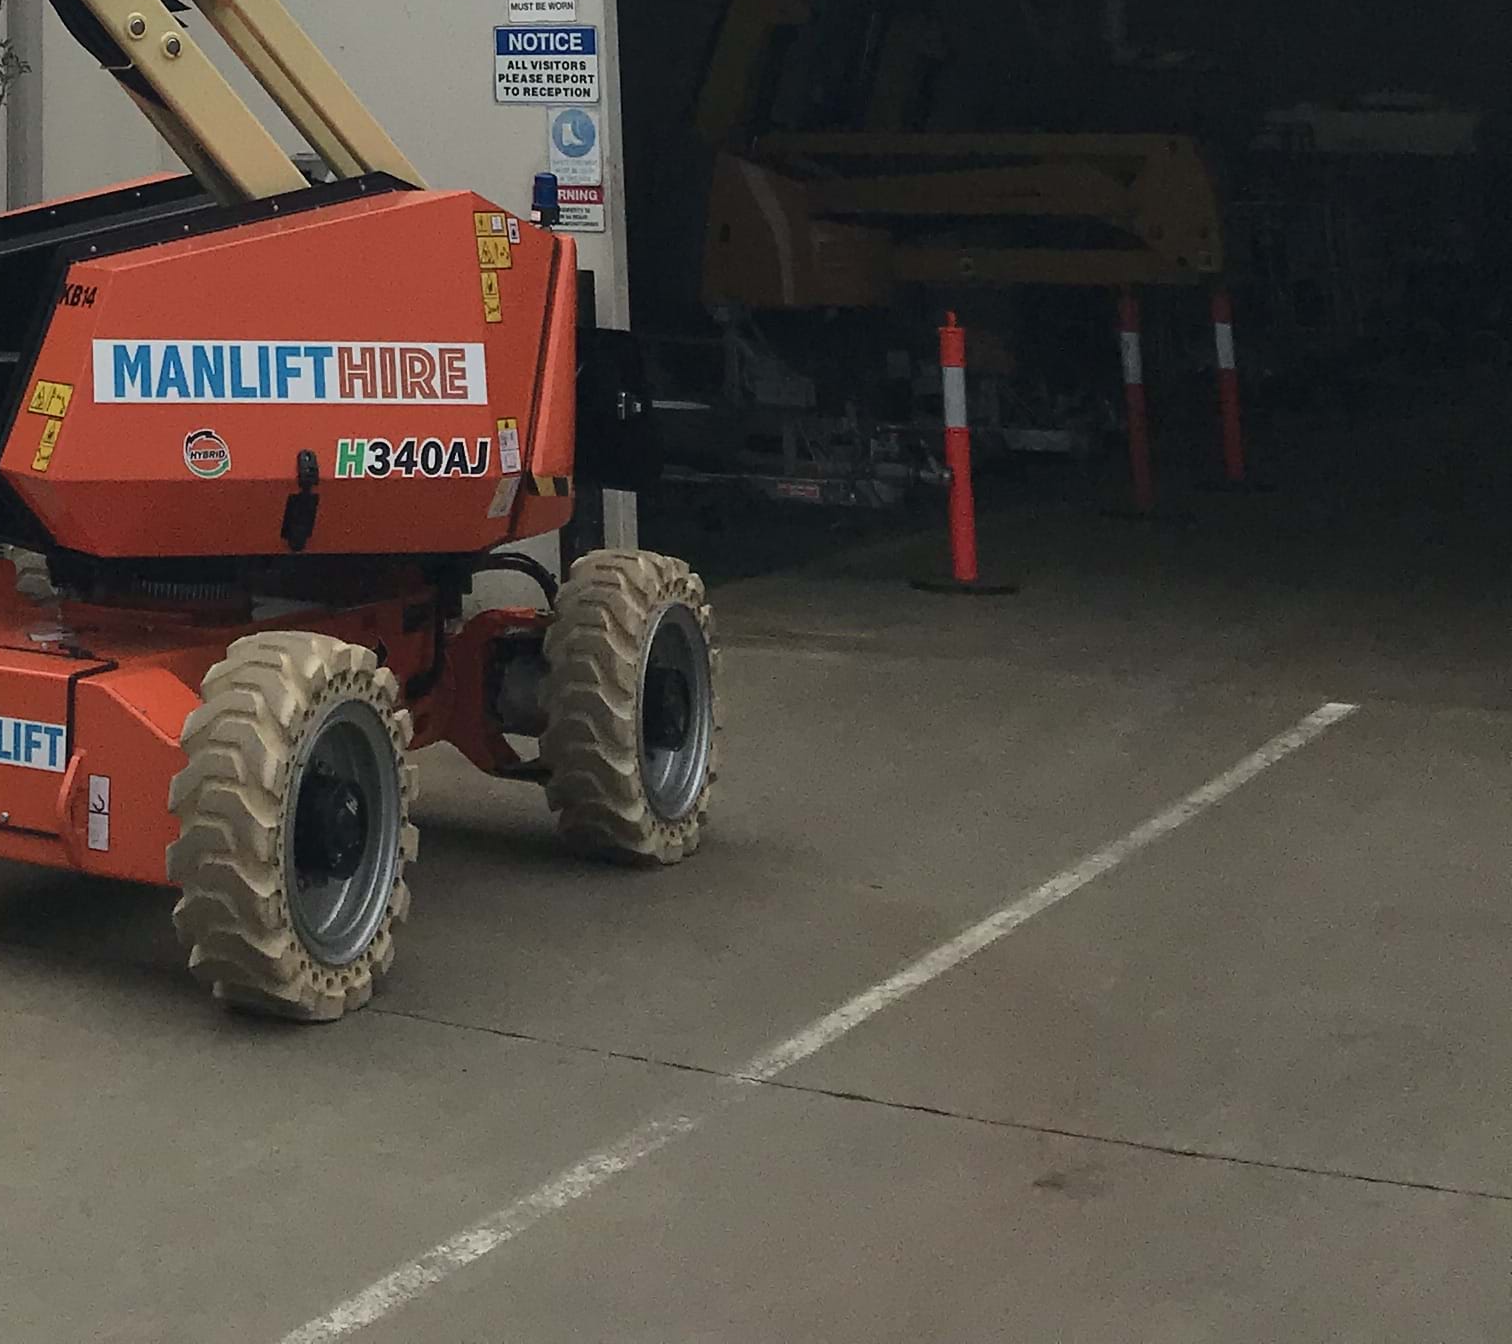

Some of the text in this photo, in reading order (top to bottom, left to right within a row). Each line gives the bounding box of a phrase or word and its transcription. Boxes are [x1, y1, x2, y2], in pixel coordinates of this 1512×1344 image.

[511, 2, 574, 11] MUST BE WORN
[508, 32, 584, 51] NOTICE
[507, 60, 587, 71] ALL VISITORS
[498, 73, 595, 84] PLEASE REPORT
[503, 87, 591, 97] TO RECEPTION
[557, 189, 598, 201] RNING
[190, 449, 226, 460] HYBRID
[336, 439, 489, 477] H340AJ
